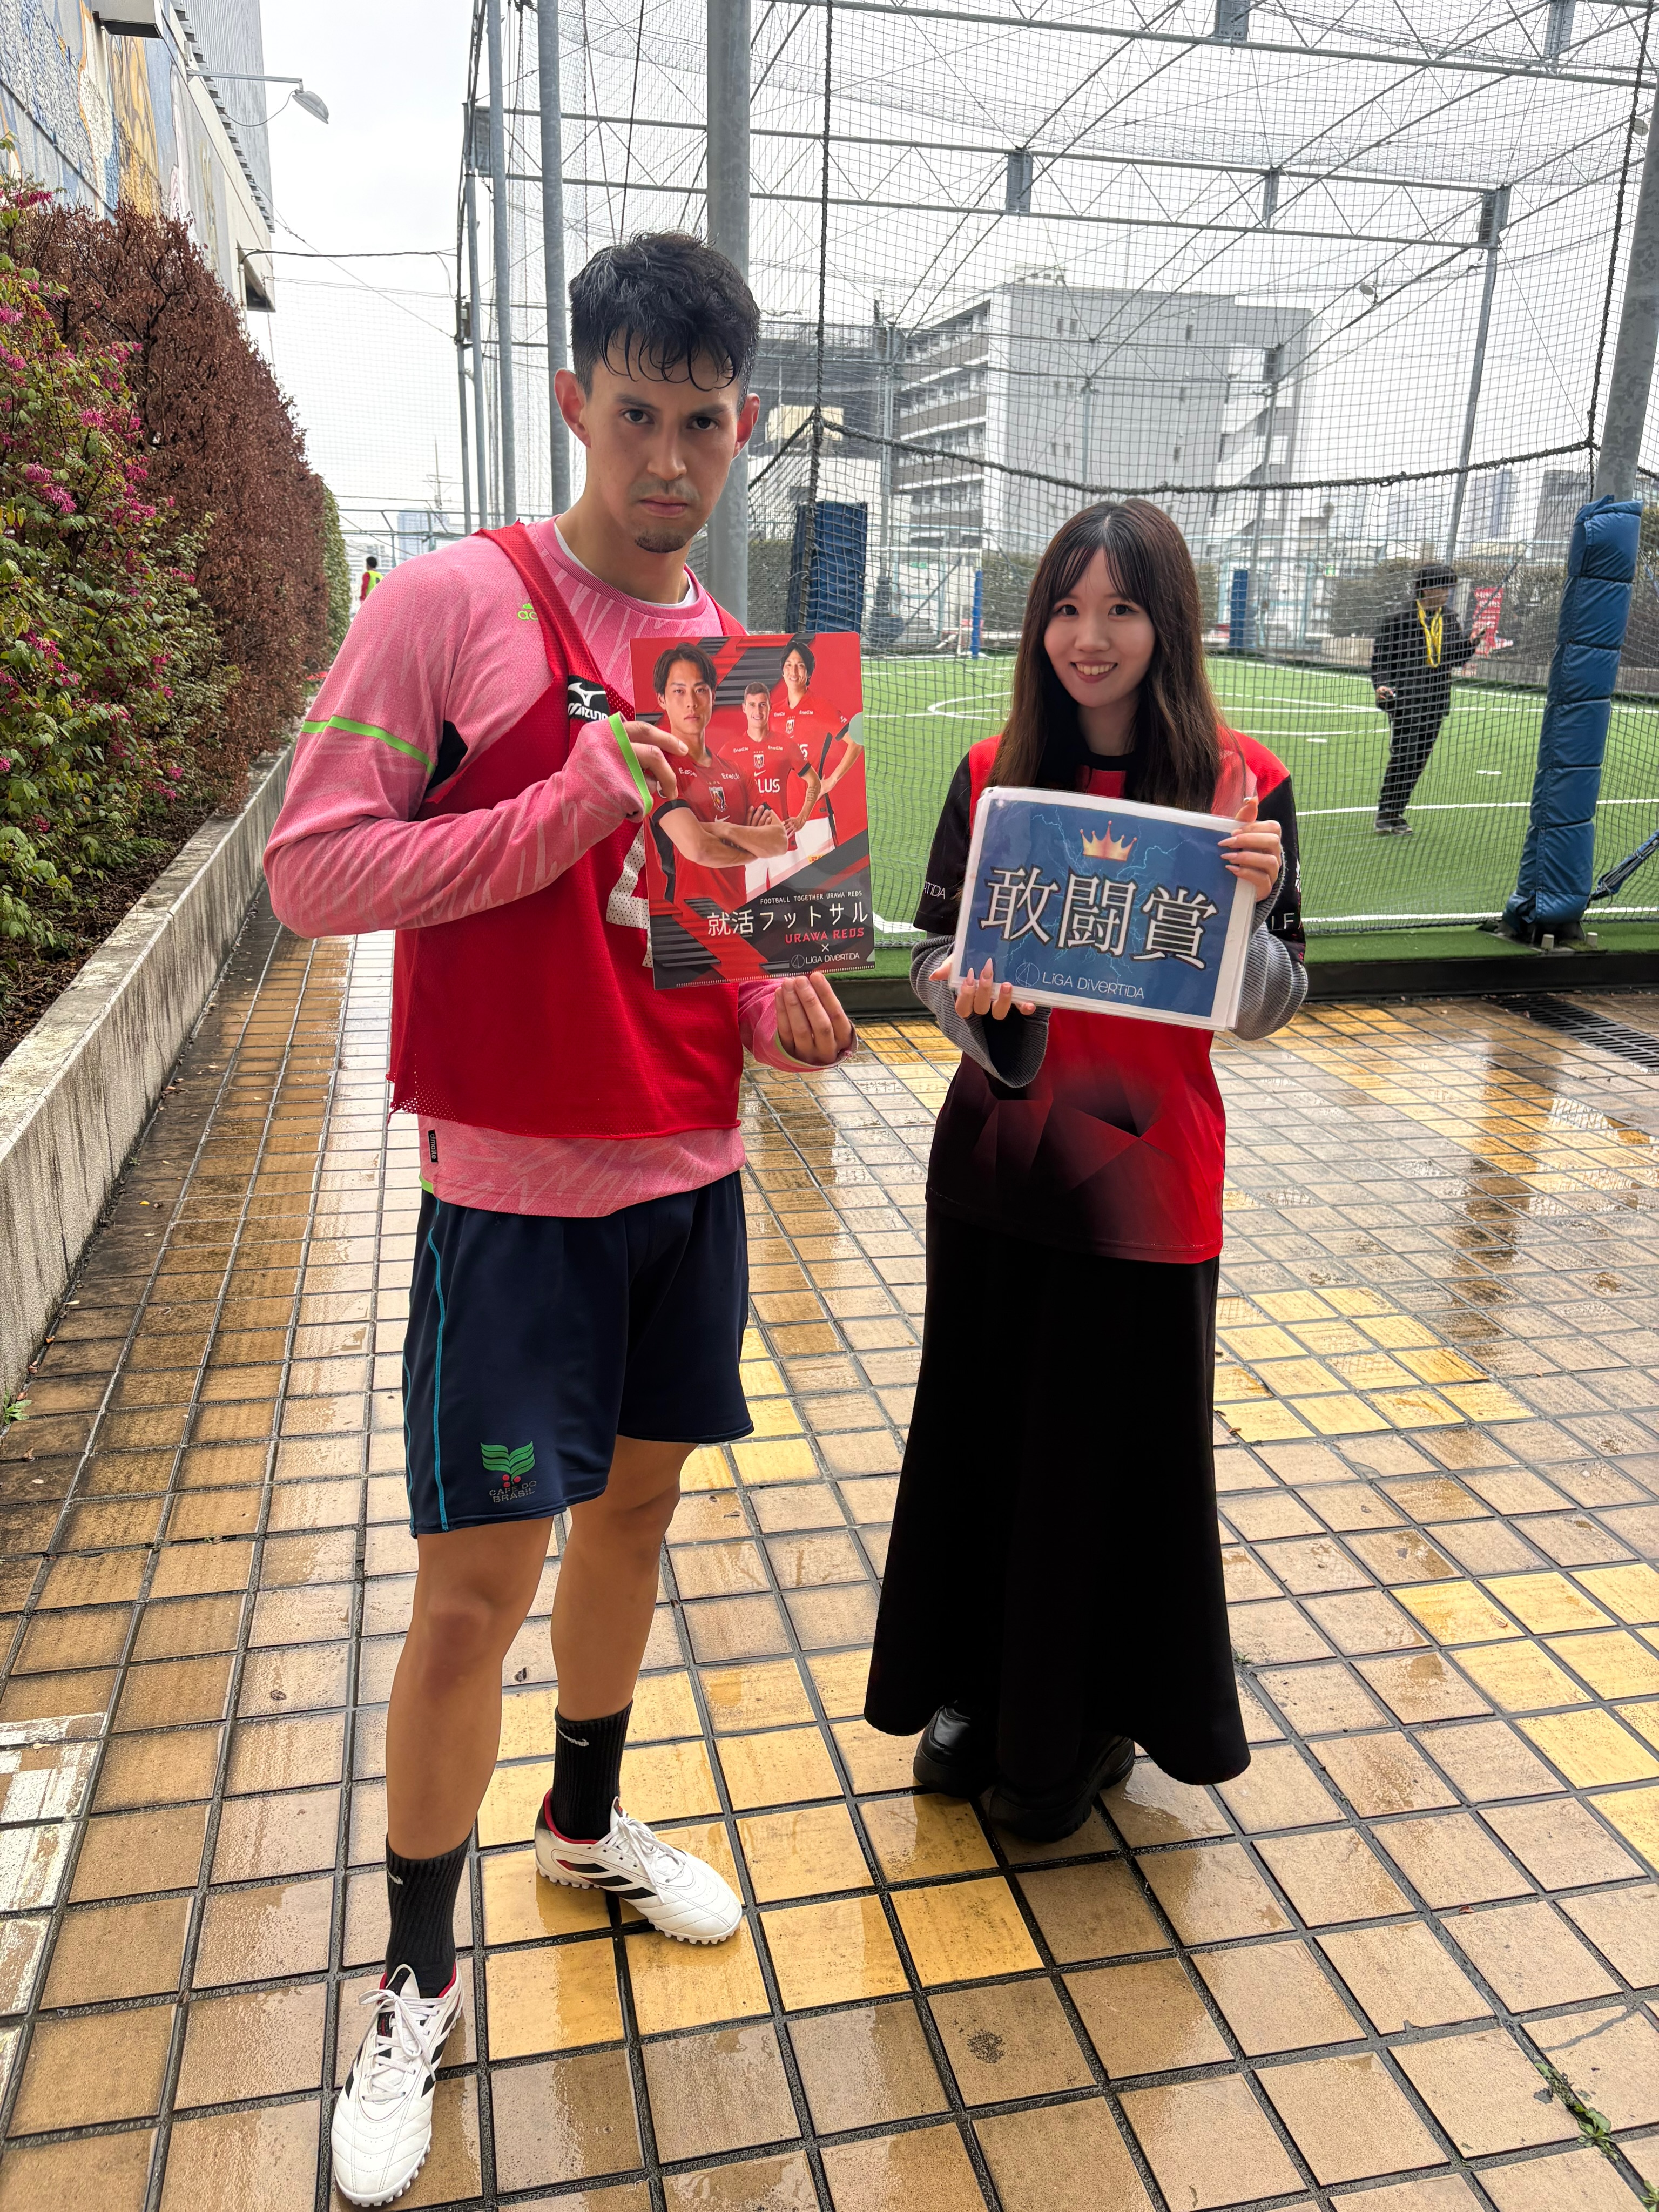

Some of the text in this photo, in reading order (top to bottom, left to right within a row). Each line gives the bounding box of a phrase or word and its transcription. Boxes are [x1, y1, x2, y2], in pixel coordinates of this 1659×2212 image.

[707, 901, 868, 937] 就活フットサル
[980, 865, 1218, 970] 敢闘賞
[785, 927, 865, 944] URAWA REDS
[521, 1480, 537, 1489] DO
[493, 1487, 535, 1503] BRASIL
